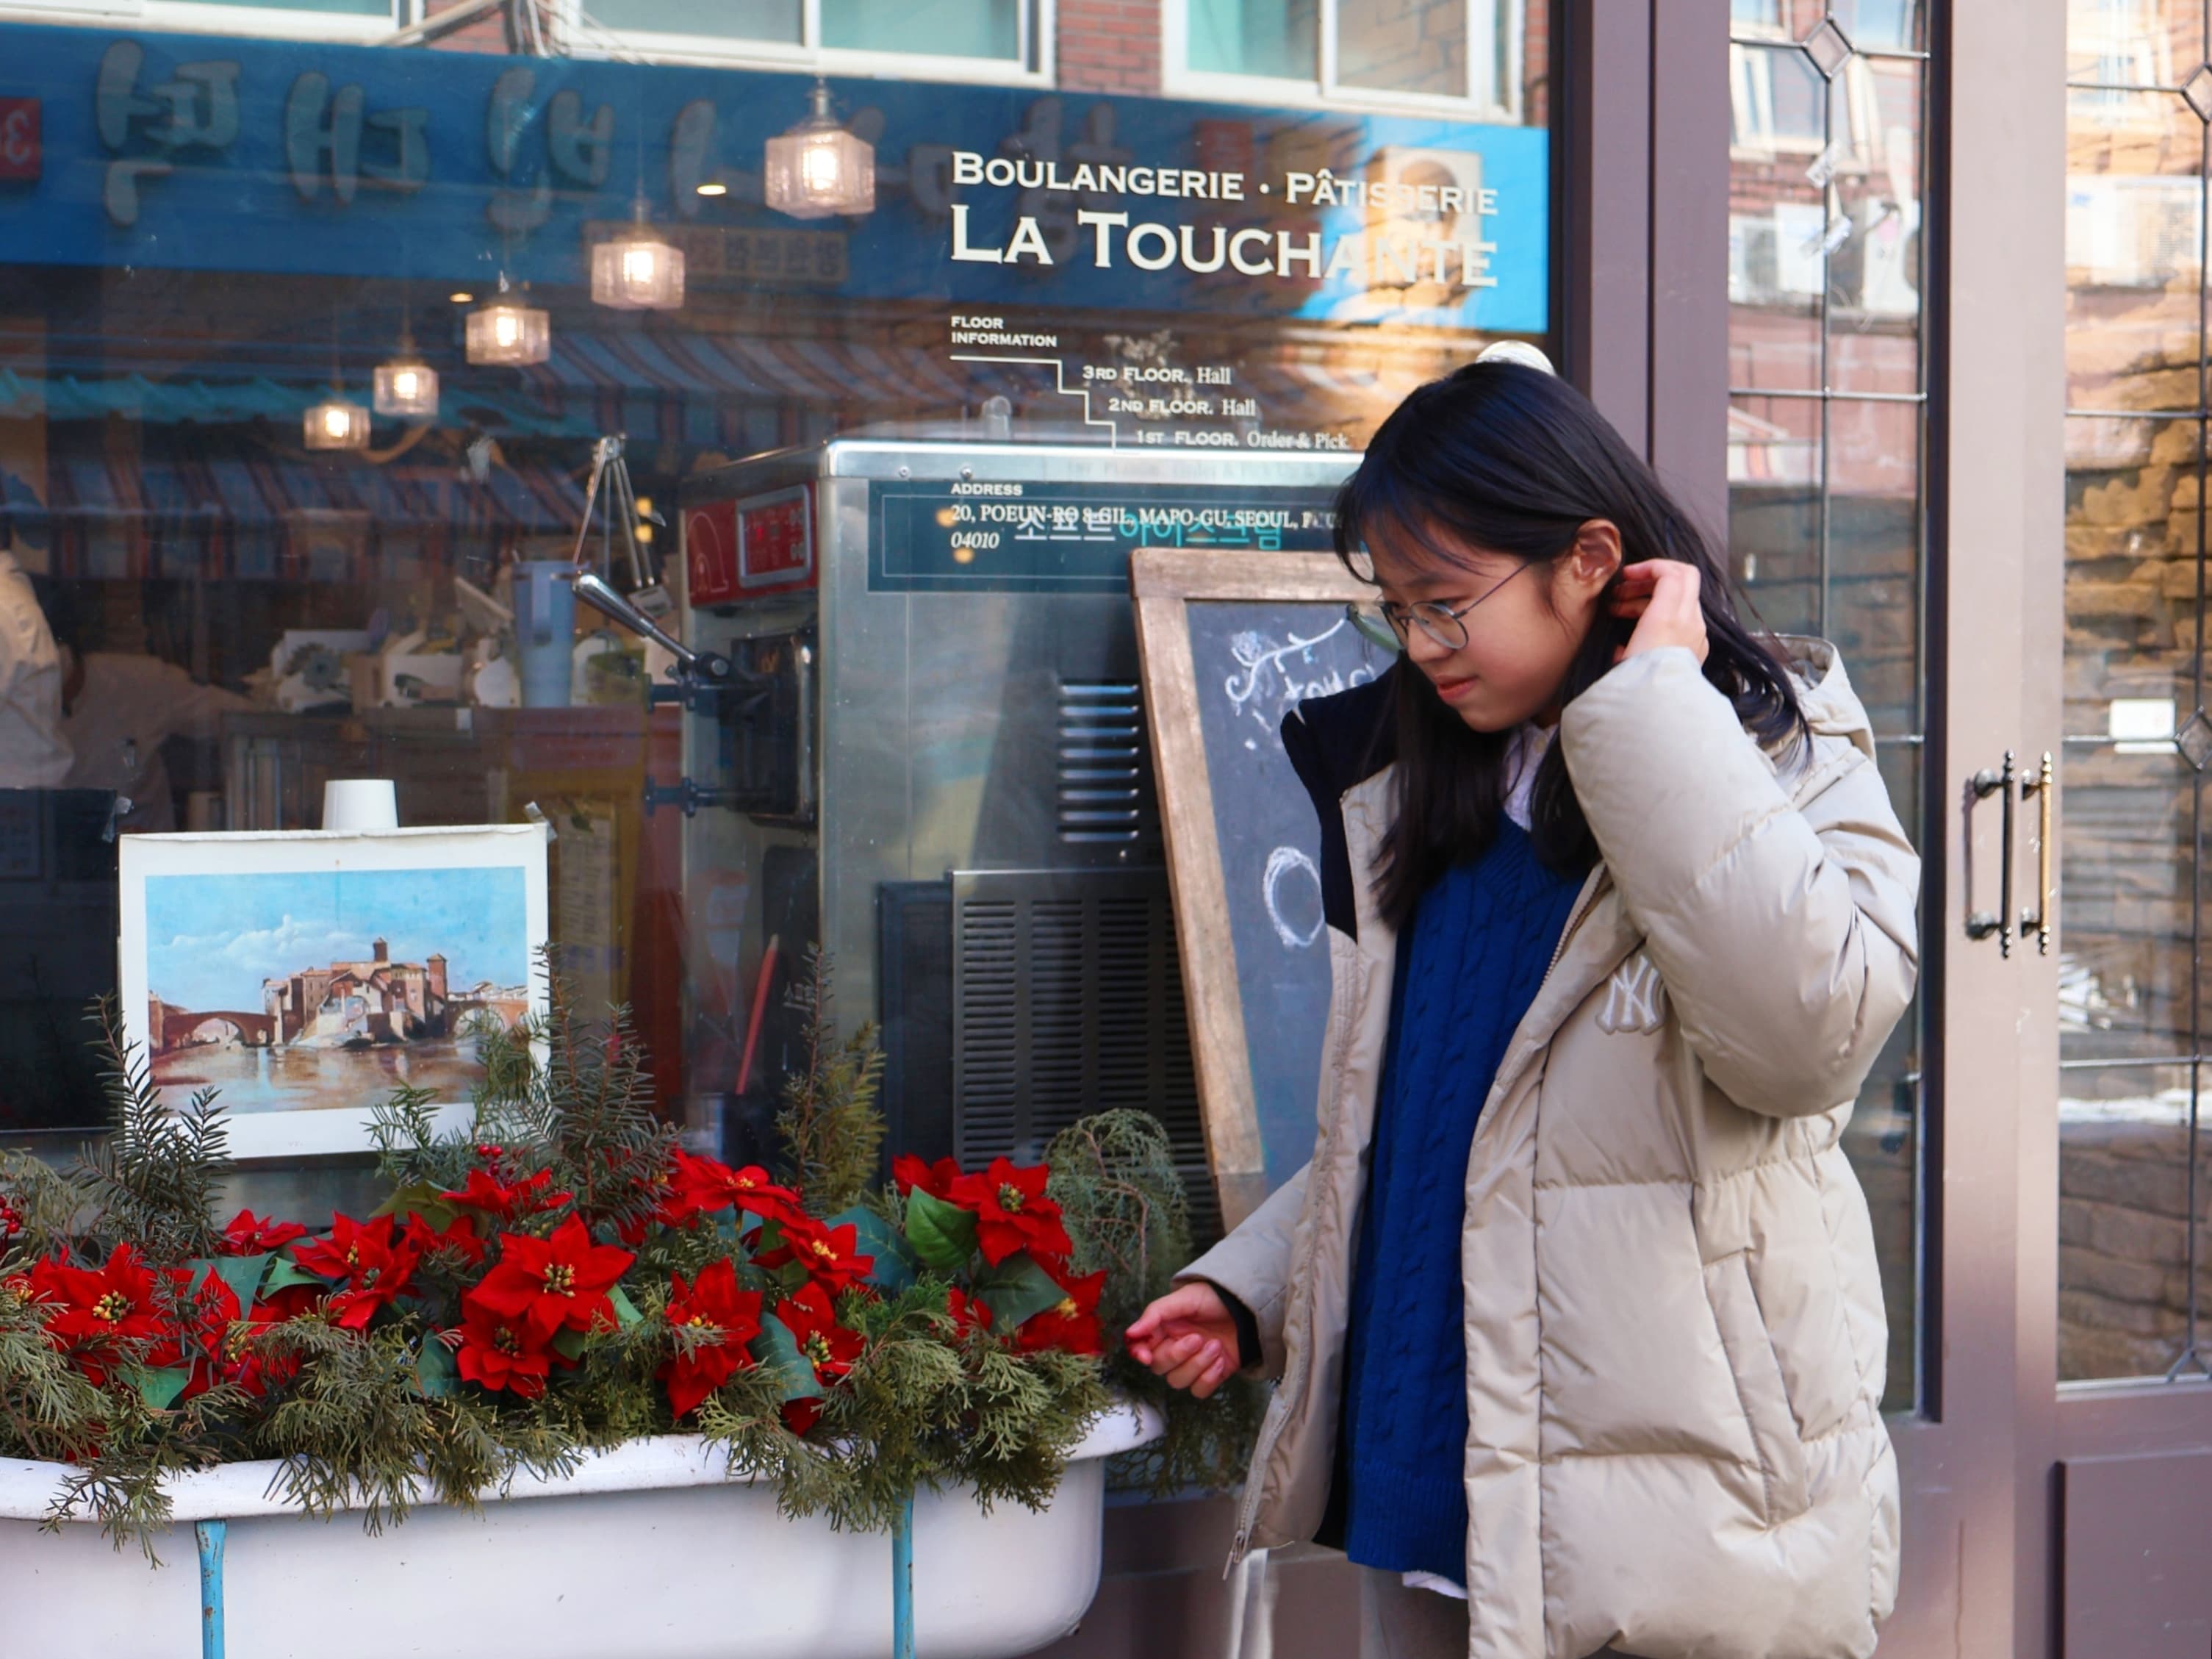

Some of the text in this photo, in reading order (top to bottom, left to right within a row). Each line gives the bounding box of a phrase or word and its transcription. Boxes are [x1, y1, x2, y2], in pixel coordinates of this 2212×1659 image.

[953, 151, 1498, 215] BOULANGERIE PÂTISSERIE
[951, 204, 1498, 287] LA TOUCHANTE
[951, 316, 1003, 329] FLOOR
[951, 332, 1057, 347] INFORMATION
[1082, 365, 1117, 380] 3RD
[1196, 366, 1231, 385] Hall
[1108, 398, 1256, 417] 2ND FLOOR. Hall
[1137, 430, 1165, 444] 1ST
[1175, 431, 1239, 447] FLOOR.
[1246, 430, 1293, 448] Order
[1296, 431, 1310, 449] &
[951, 484, 1023, 496] ADDRESS
[951, 504, 976, 523] 20,
[980, 505, 1080, 524] POEUN-RO
[1235, 509, 1299, 530] SEOUL,
[951, 532, 1000, 548] 04010
